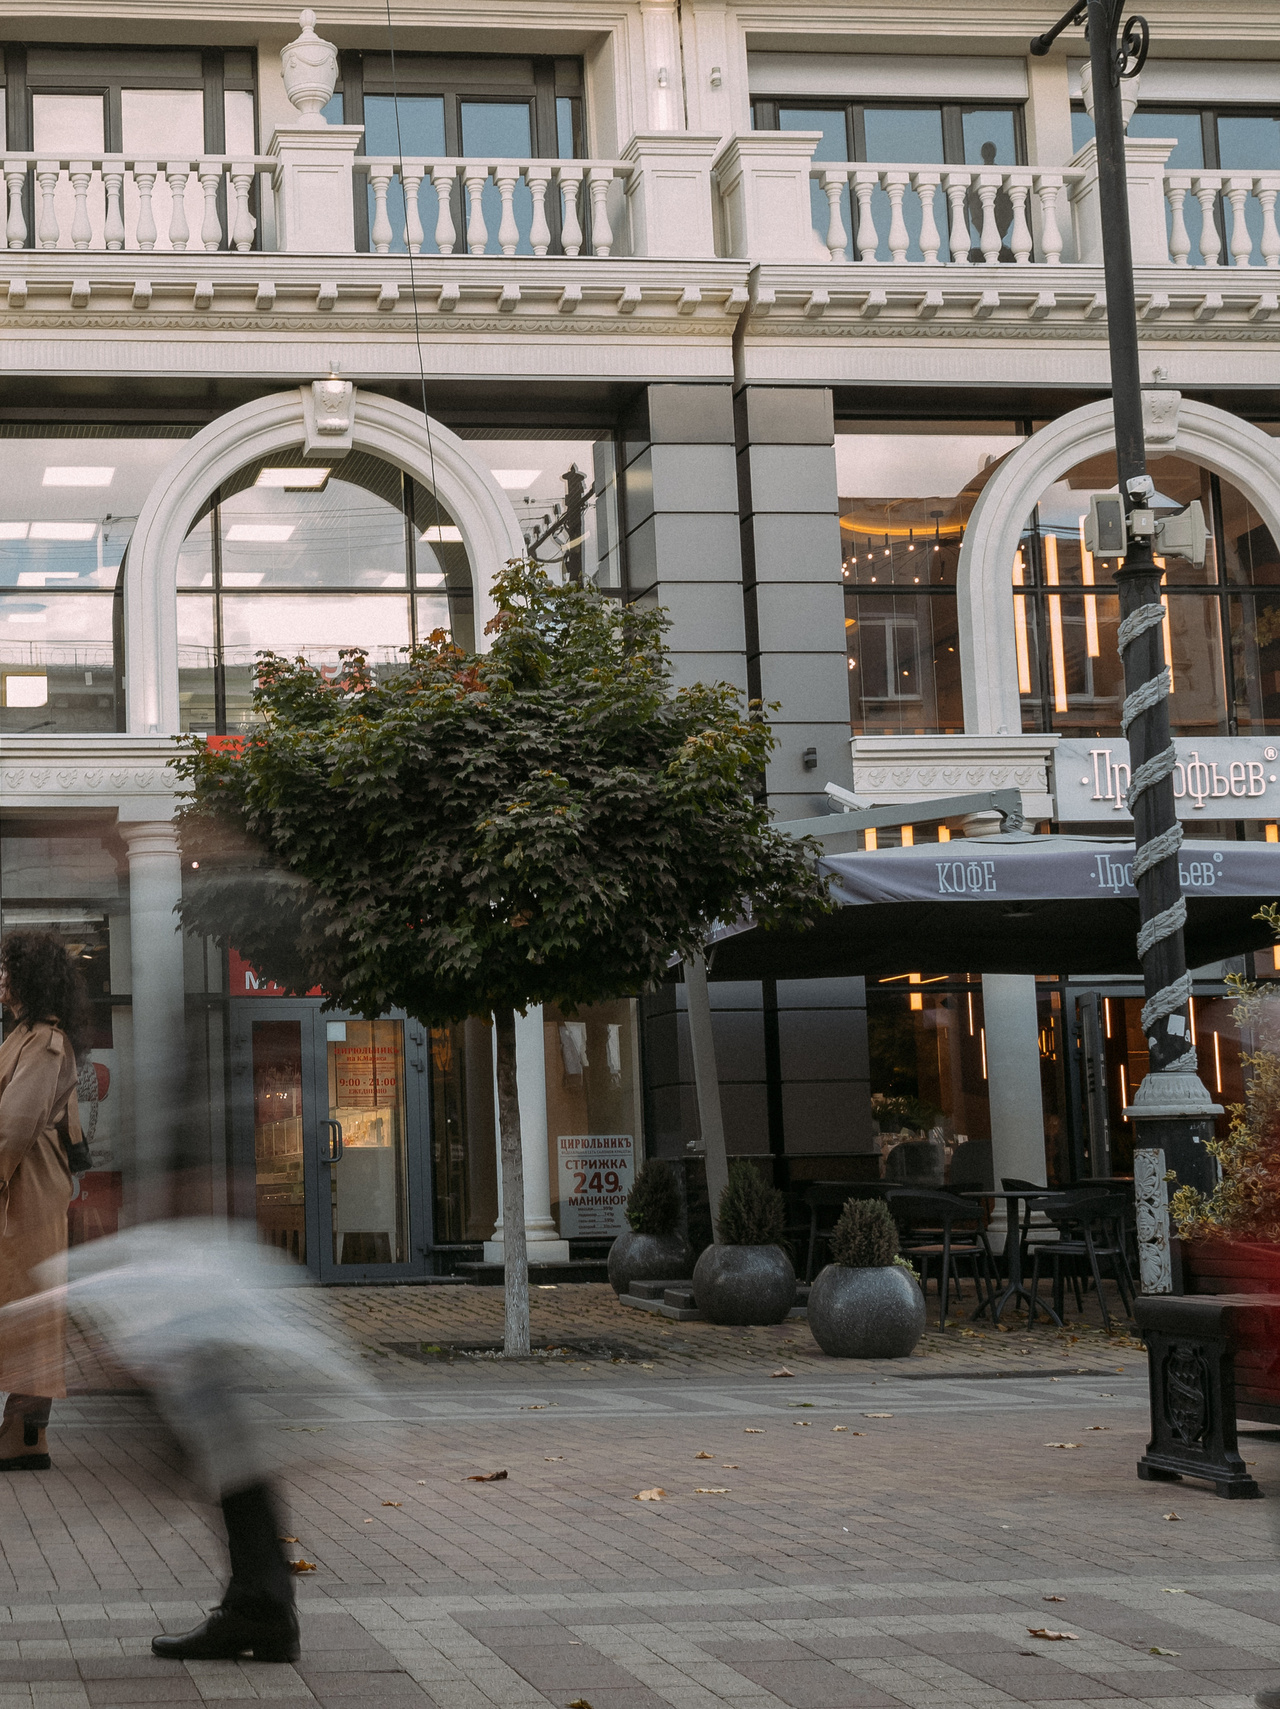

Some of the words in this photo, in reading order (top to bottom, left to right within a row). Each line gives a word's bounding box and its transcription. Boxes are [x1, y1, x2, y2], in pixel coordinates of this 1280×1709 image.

[935, 861, 997, 894] КОФЕ
[339, 1078, 361, 1087] 9:00
[560, 1138, 632, 1151] ЦИРЮЛЬНИКЪ
[565, 1159, 627, 1170] СТРИЖКА
[573, 1171, 619, 1194] 249
[568, 1195, 627, 1206] МАНИКЮР
